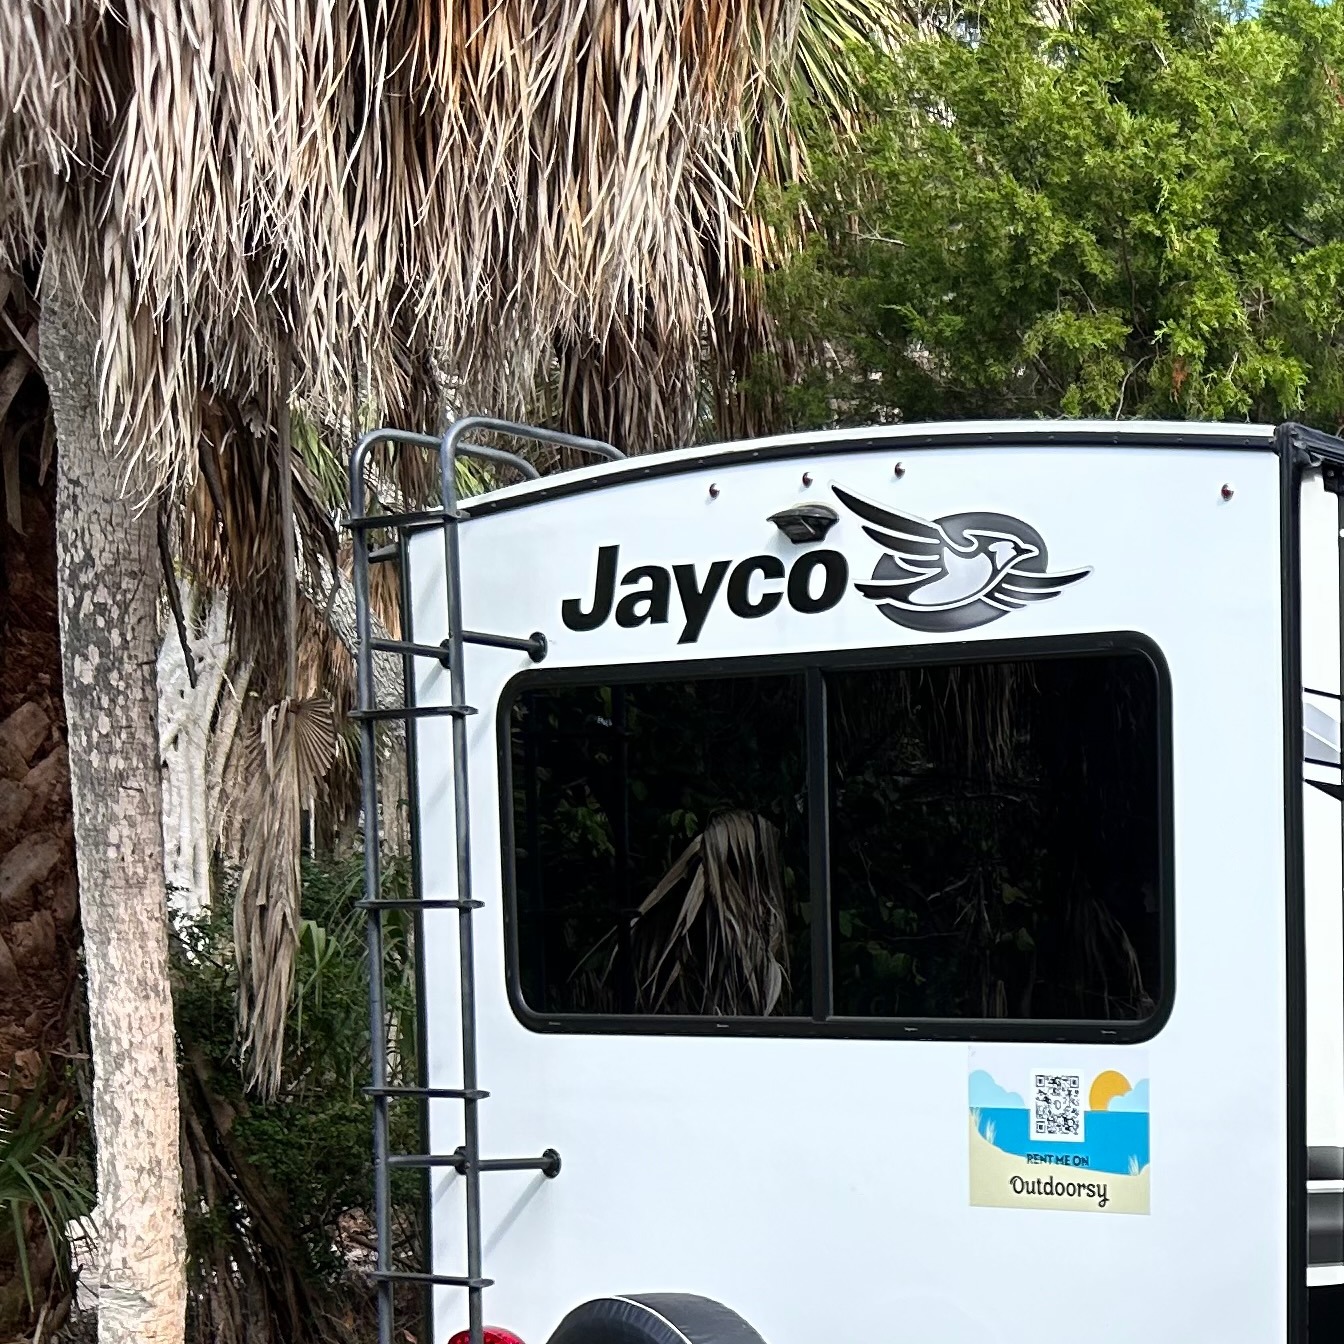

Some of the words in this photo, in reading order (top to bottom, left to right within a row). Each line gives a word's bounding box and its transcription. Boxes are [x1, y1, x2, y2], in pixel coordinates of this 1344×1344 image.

[561, 544, 850, 645] Jayco
[1026, 1153, 1054, 1165] RENT
[1055, 1154, 1071, 1166] ME
[1072, 1155, 1090, 1167] ON
[1009, 1175, 1110, 1208] Outdoorsy
